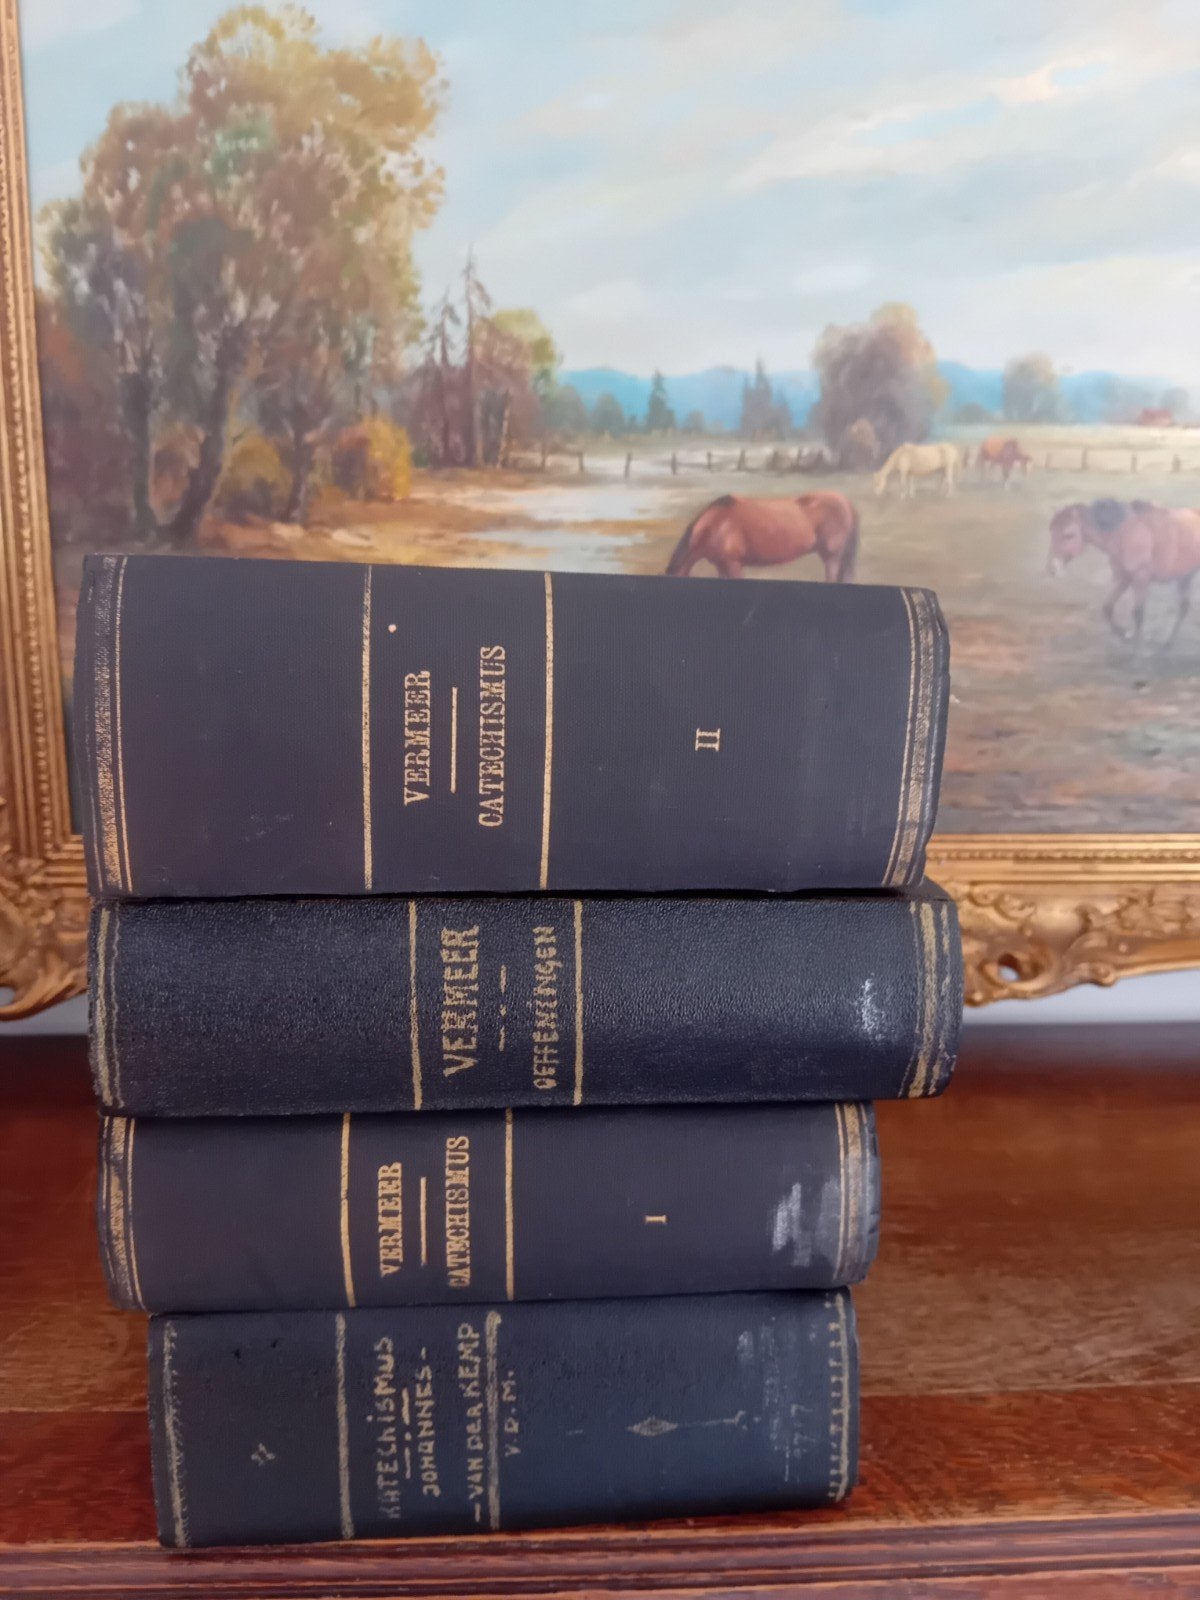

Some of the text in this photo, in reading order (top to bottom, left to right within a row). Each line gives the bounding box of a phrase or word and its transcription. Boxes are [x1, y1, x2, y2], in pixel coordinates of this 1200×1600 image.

[403, 670, 432, 806] VERMEER
[478, 644, 507, 828] CATECHISMUS
[694, 726, 722, 753] II
[440, 924, 480, 1079] VERMEER
[444, 1135, 472, 1290] CATECHISMUS
[457, 1321, 482, 1398] KEMP
